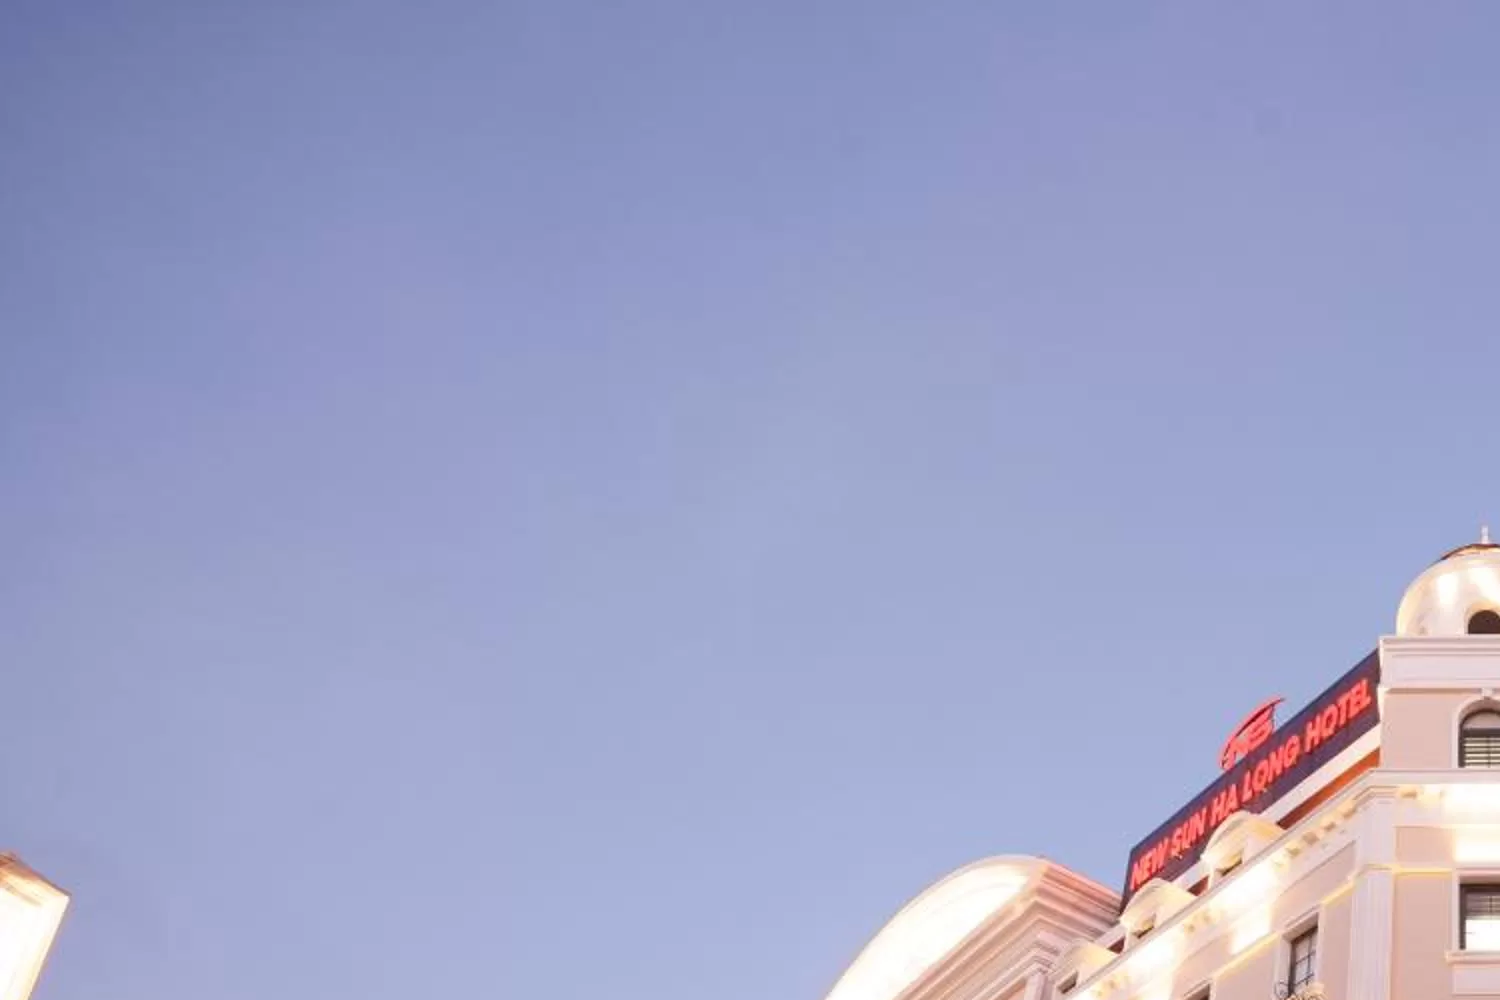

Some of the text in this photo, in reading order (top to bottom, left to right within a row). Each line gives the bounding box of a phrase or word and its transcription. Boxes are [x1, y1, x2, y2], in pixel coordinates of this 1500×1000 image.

[1130, 838, 1169, 891] NEW
[1170, 807, 1207, 856] SUN
[1242, 735, 1299, 803] LONG
[1304, 678, 1372, 753] HOTEL
